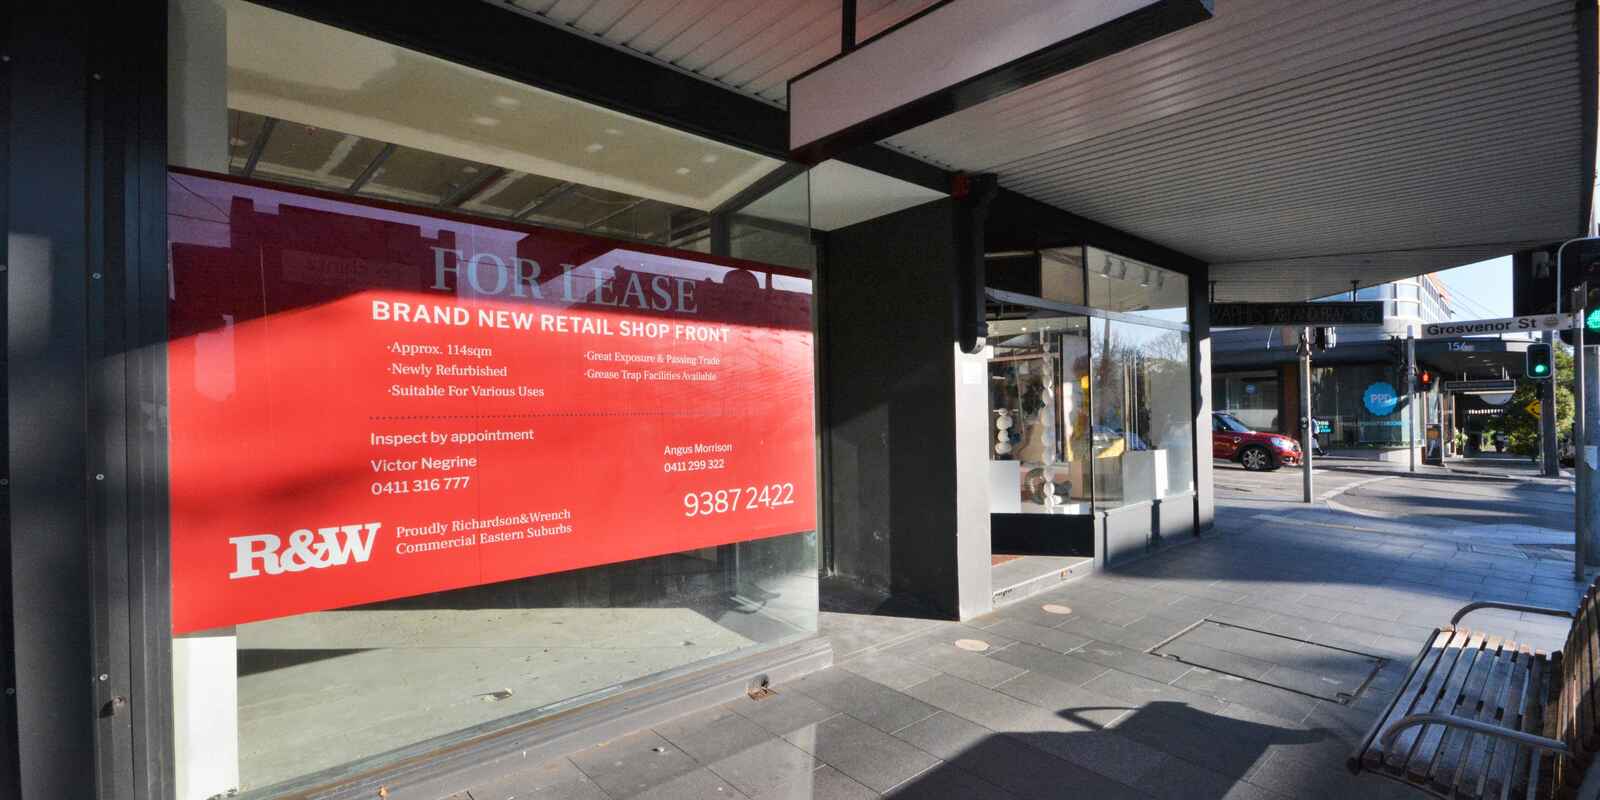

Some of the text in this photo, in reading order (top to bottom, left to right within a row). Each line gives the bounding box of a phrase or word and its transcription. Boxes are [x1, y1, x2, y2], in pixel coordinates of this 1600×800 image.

[429, 246, 544, 300] FOR
[559, 262, 699, 314] LEASE
[372, 299, 731, 343] BRAND NEW RETAIL SHOP FRONT
[1427, 317, 1537, 336] Grosvenor St
[447, 344, 493, 359] 114sqm
[614, 352, 656, 365] Exposure
[657, 354, 664, 363] &
[666, 354, 697, 366] Passing
[699, 355, 721, 366] Trade
[436, 364, 508, 377] Refurbished
[622, 370, 642, 382] Trap
[644, 370, 681, 381] Facilities
[682, 372, 717, 381] Available
[448, 386, 469, 397] For
[471, 386, 515, 397] Various
[518, 386, 545, 397] Uses
[370, 428, 535, 447] Inspect by appointment
[664, 442, 733, 456] Angus Morrison
[370, 455, 478, 473] Victor Negrine
[664, 458, 725, 473] 0411 299 322
[371, 475, 471, 496] 0411 316 777
[684, 482, 795, 517] 9387 2422
[396, 522, 448, 539] Proudly
[396, 522, 573, 556] Commercial Eastern Suburbs
[228, 522, 382, 580] R&W
